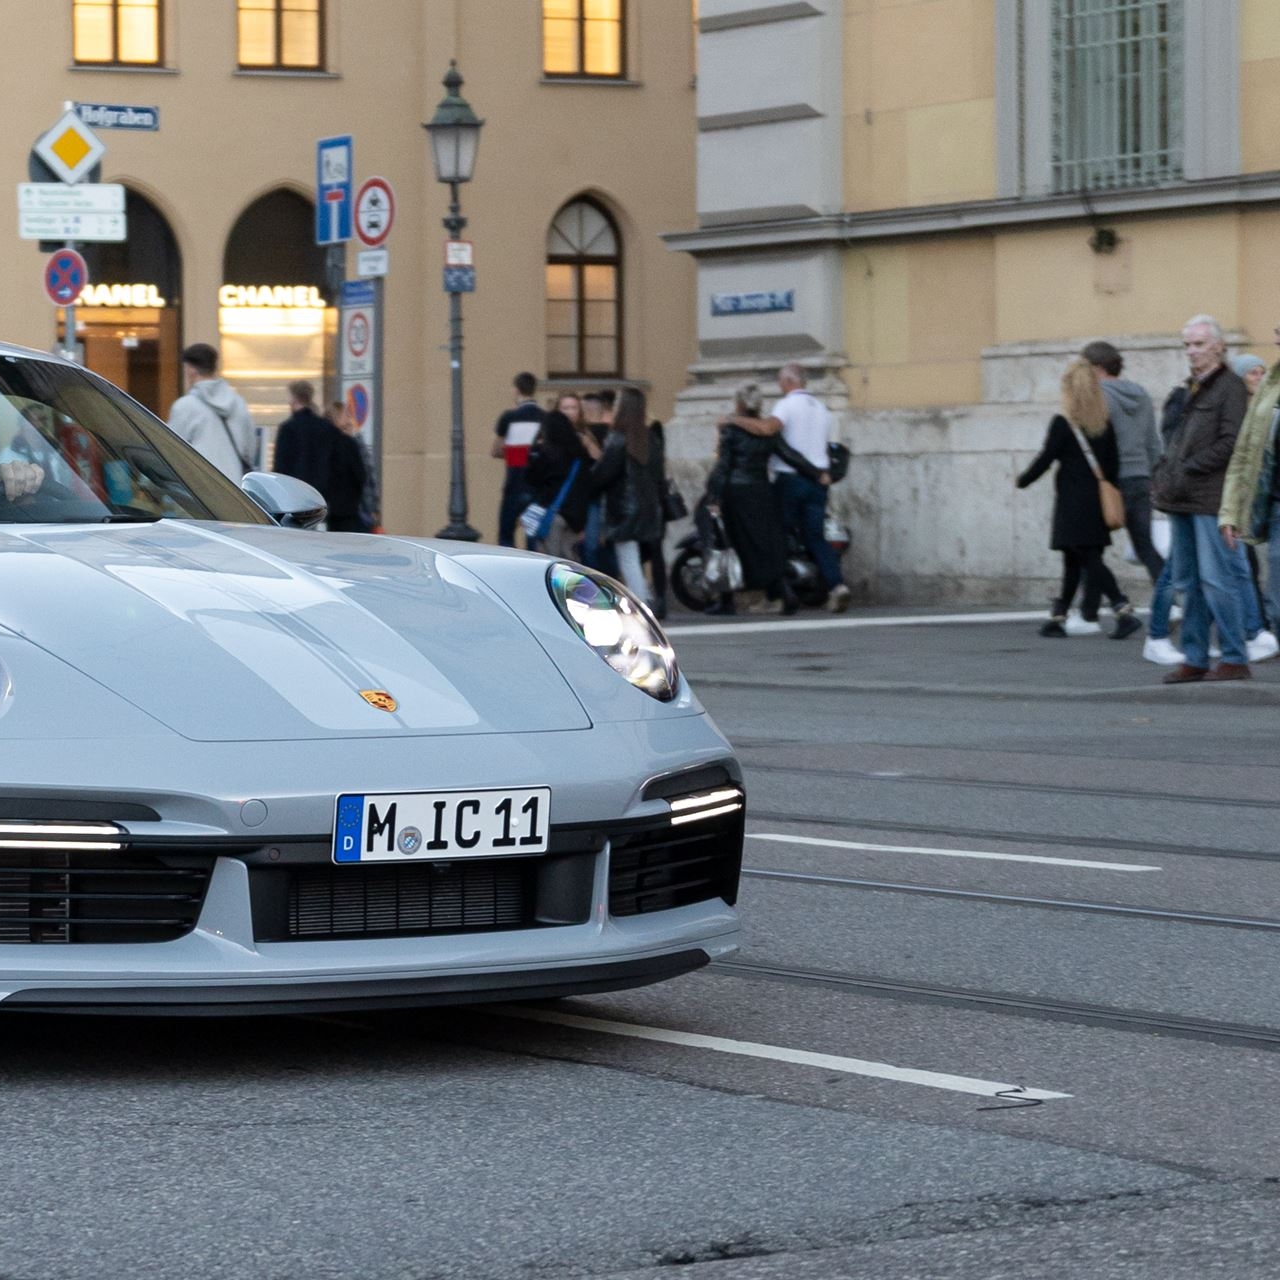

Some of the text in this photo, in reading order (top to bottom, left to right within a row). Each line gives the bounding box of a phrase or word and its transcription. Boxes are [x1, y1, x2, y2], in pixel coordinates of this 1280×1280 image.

[81, 105, 154, 127] Hofgraben
[219, 284, 326, 308] CHANEL
[367, 802, 397, 852] M
[343, 835, 354, 851] D
